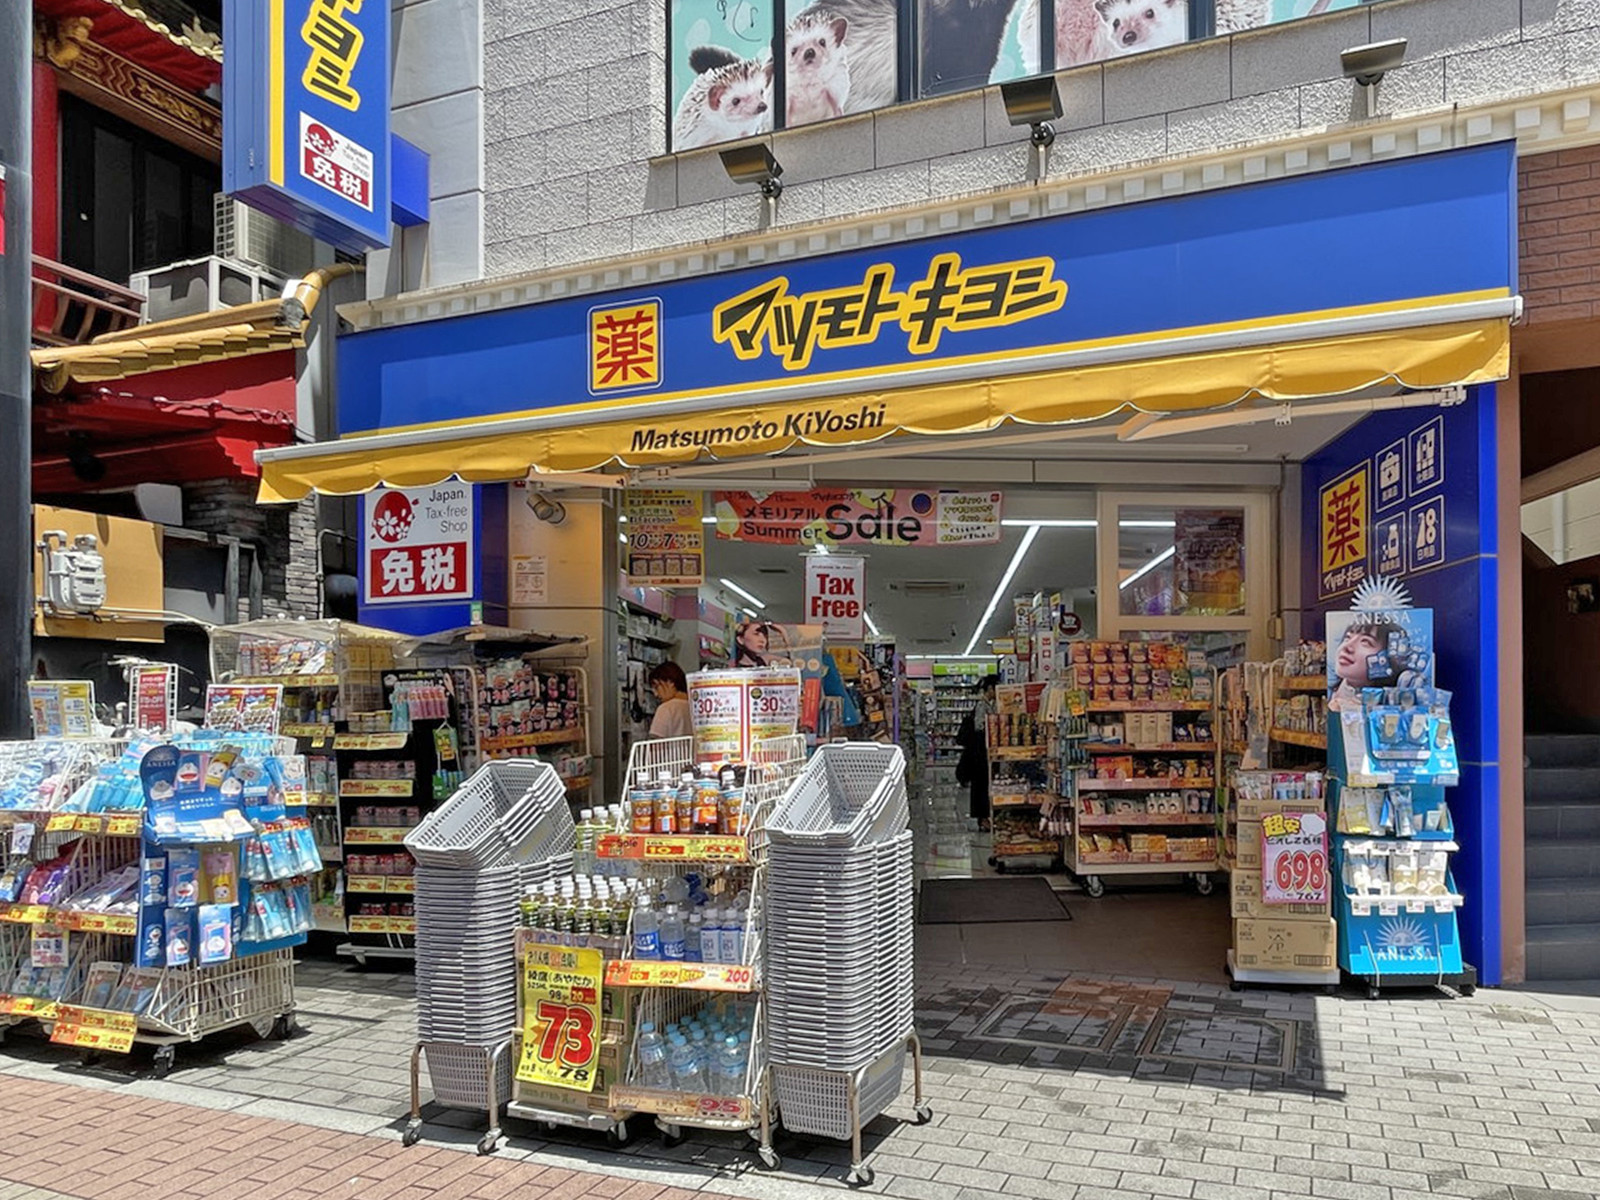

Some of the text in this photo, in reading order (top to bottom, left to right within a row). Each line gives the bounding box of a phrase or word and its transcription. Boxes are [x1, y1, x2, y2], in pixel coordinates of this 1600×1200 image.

[312, 156, 363, 202] 免税
[714, 254, 1066, 369] マツモトキヨシ
[596, 310, 655, 385] 薬
[631, 404, 887, 453] Matsumoto KiYoshi
[425, 506, 468, 520] Tax-free
[743, 505, 821, 521] メモリアル
[825, 499, 922, 541] Sale
[1327, 479, 1361, 567] 薬
[440, 521, 468, 534] Shop
[743, 521, 822, 539] Summer
[381, 546, 456, 595] 免税
[816, 573, 855, 595] Tax
[811, 596, 860, 618] Free
[1275, 850, 1327, 892] 698
[1296, 891, 1322, 900] 767
[1376, 946, 1435, 961] ANESSA
[725, 969, 749, 983] 200
[537, 1000, 597, 1068] 73
[559, 1066, 590, 1082] 78
